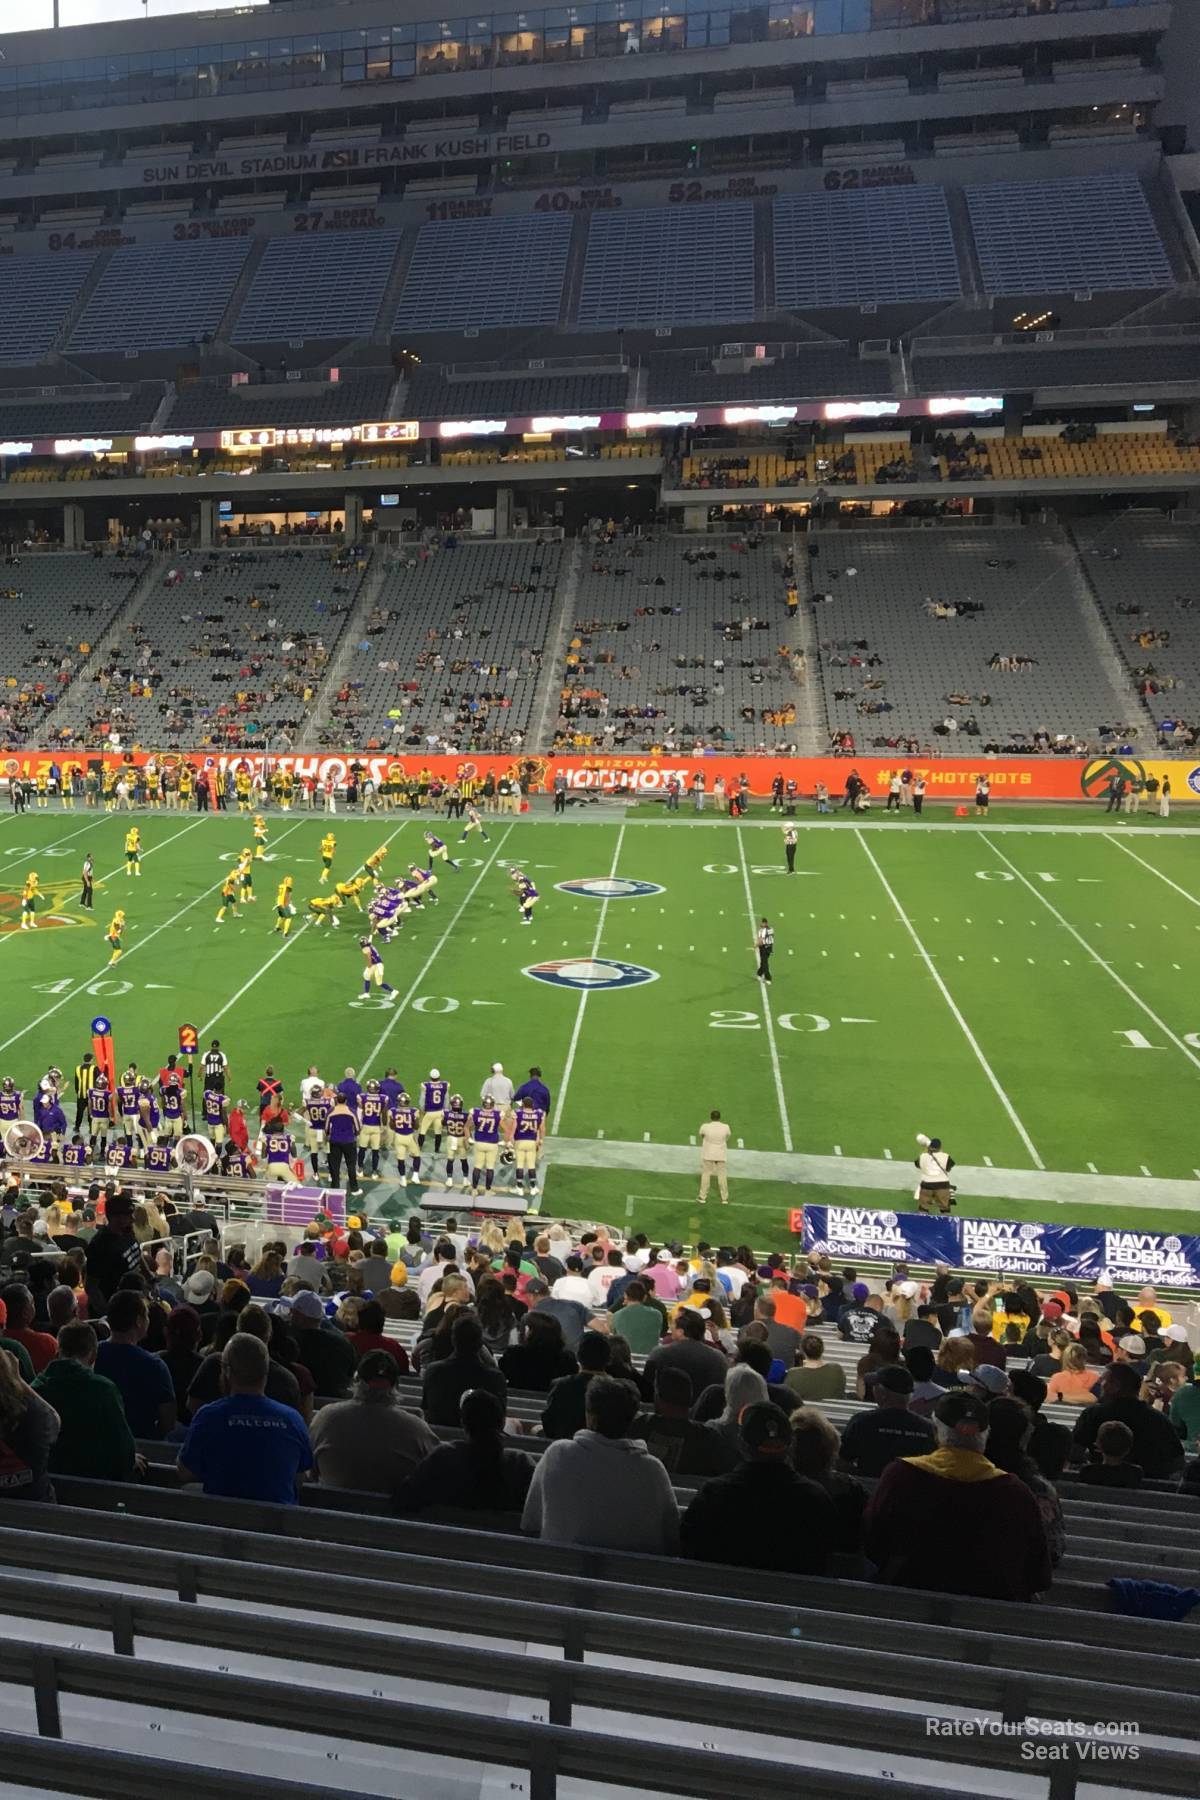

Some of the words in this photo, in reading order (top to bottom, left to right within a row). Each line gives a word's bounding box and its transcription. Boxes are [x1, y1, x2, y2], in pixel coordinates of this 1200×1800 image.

[143, 166, 179, 183] SUN
[186, 161, 233, 179] DEVIL
[241, 154, 316, 174] STADIUM
[364, 143, 428, 164] FRANK
[435, 137, 487, 157] KUSH
[496, 133, 550, 152] FIELD
[824, 168, 860, 191] 62
[534, 191, 570, 211] 40
[668, 182, 703, 203] 52
[704, 184, 778, 200] PRITCHARD
[426, 200, 448, 219] 11
[294, 212, 324, 231] 27
[173, 222, 201, 241] 33
[48, 232, 76, 251] 84
[582, 760, 659, 768] ARIZONA
[30, 977, 135, 997] 40
[708, 1009, 832, 1033] 20
[181, 1028, 196, 1047] 2
[91, 1097, 105, 1112] 10
[123, 1094, 135, 1108] 17
[432, 1090, 441, 1104] 6
[310, 1106, 328, 1121] 80
[364, 1101, 381, 1117] 84
[395, 1113, 412, 1129] 24
[446, 1120, 464, 1135] 26
[477, 1116, 495, 1134] 77
[269, 1138, 288, 1153] 90
[65, 1150, 79, 1164] 91
[108, 1150, 125, 1166] 95
[150, 1151, 167, 1167] 94
[827, 1207, 878, 1225] NAVY
[827, 1221, 907, 1242] FEDERAL
[963, 1221, 1017, 1239] NAVY
[828, 1240, 867, 1256] Credit
[868, 1244, 907, 1260] Union
[963, 1235, 1046, 1256] FEDERAL
[1105, 1232, 1160, 1251] NAVY
[963, 1251, 1006, 1269] Credit
[1006, 1255, 1046, 1273] Union
[1105, 1246, 1193, 1267] FEDERAL
[1105, 1265, 1148, 1282] Credit
[1149, 1268, 1192, 1286] Union
[227, 1419, 288, 1429] FALCONS
[881, 1769, 895, 1778] 12
